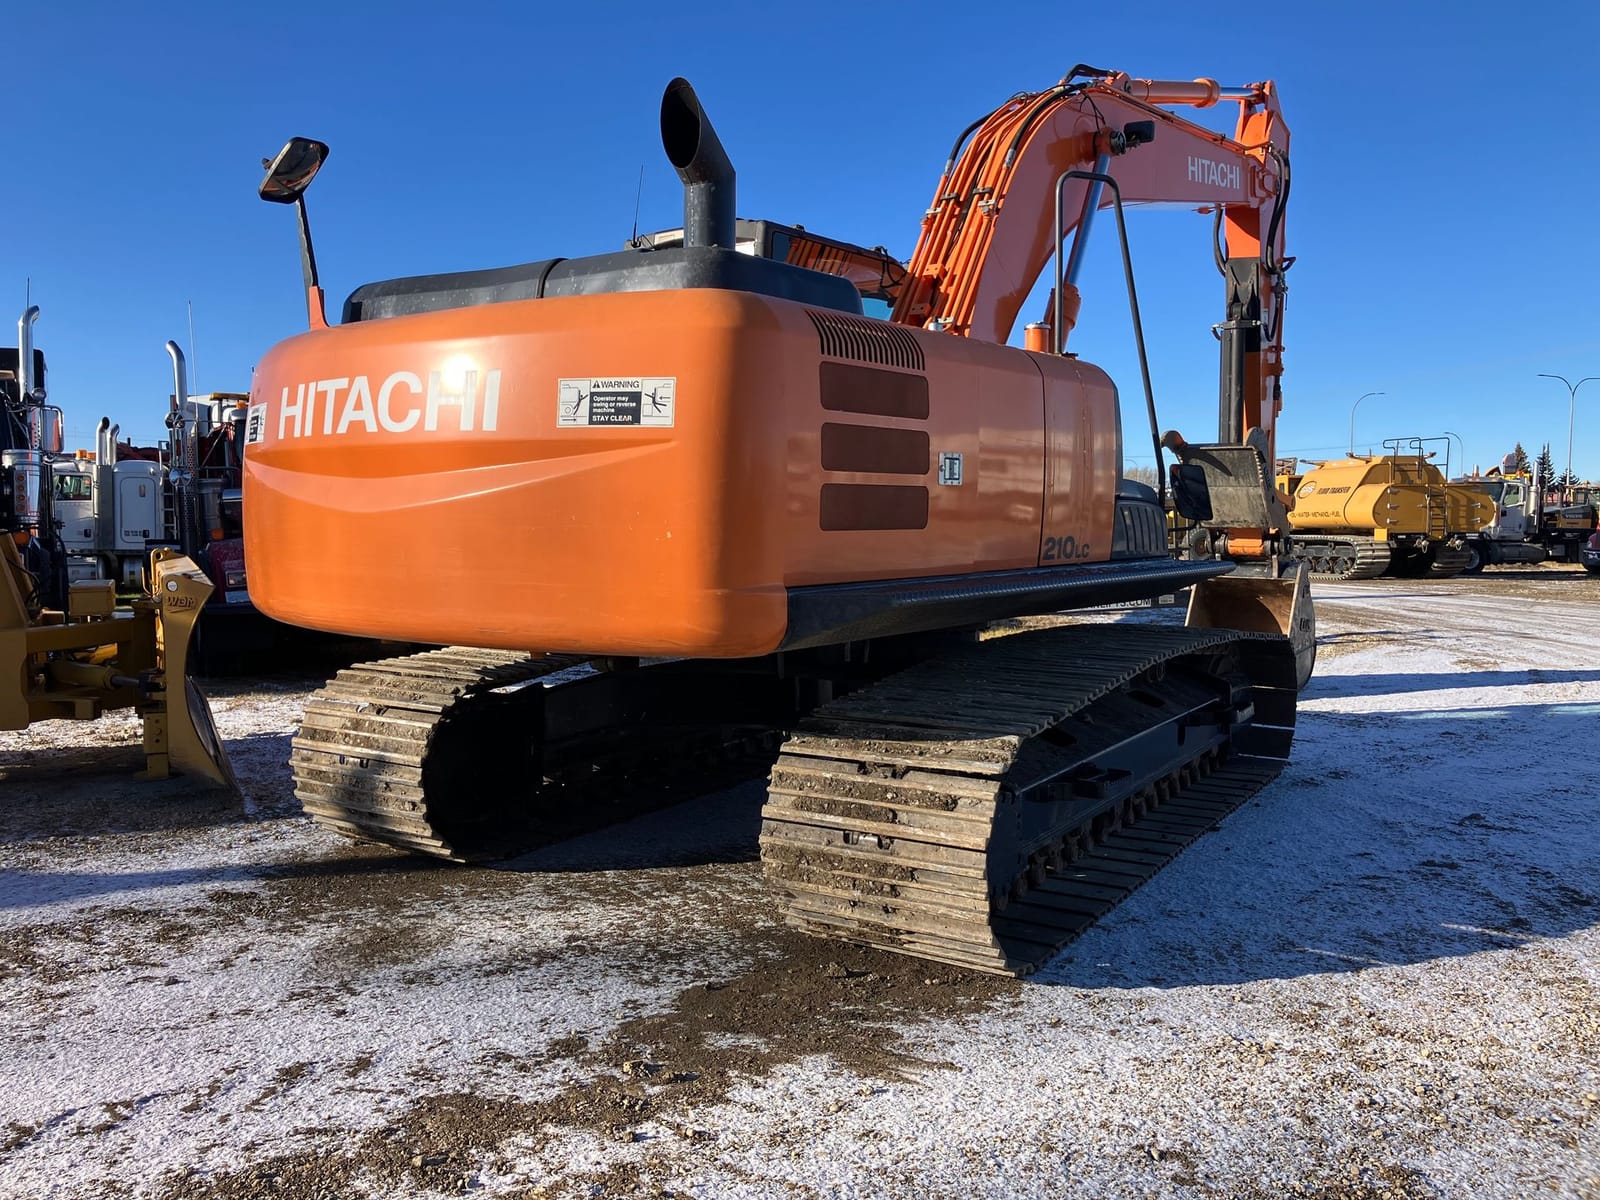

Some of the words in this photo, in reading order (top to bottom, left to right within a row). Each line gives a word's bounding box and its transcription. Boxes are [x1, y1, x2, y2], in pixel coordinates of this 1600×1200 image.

[1188, 156, 1240, 190] HITACHI
[601, 381, 640, 389] WARNING
[278, 370, 501, 440] HITACHI
